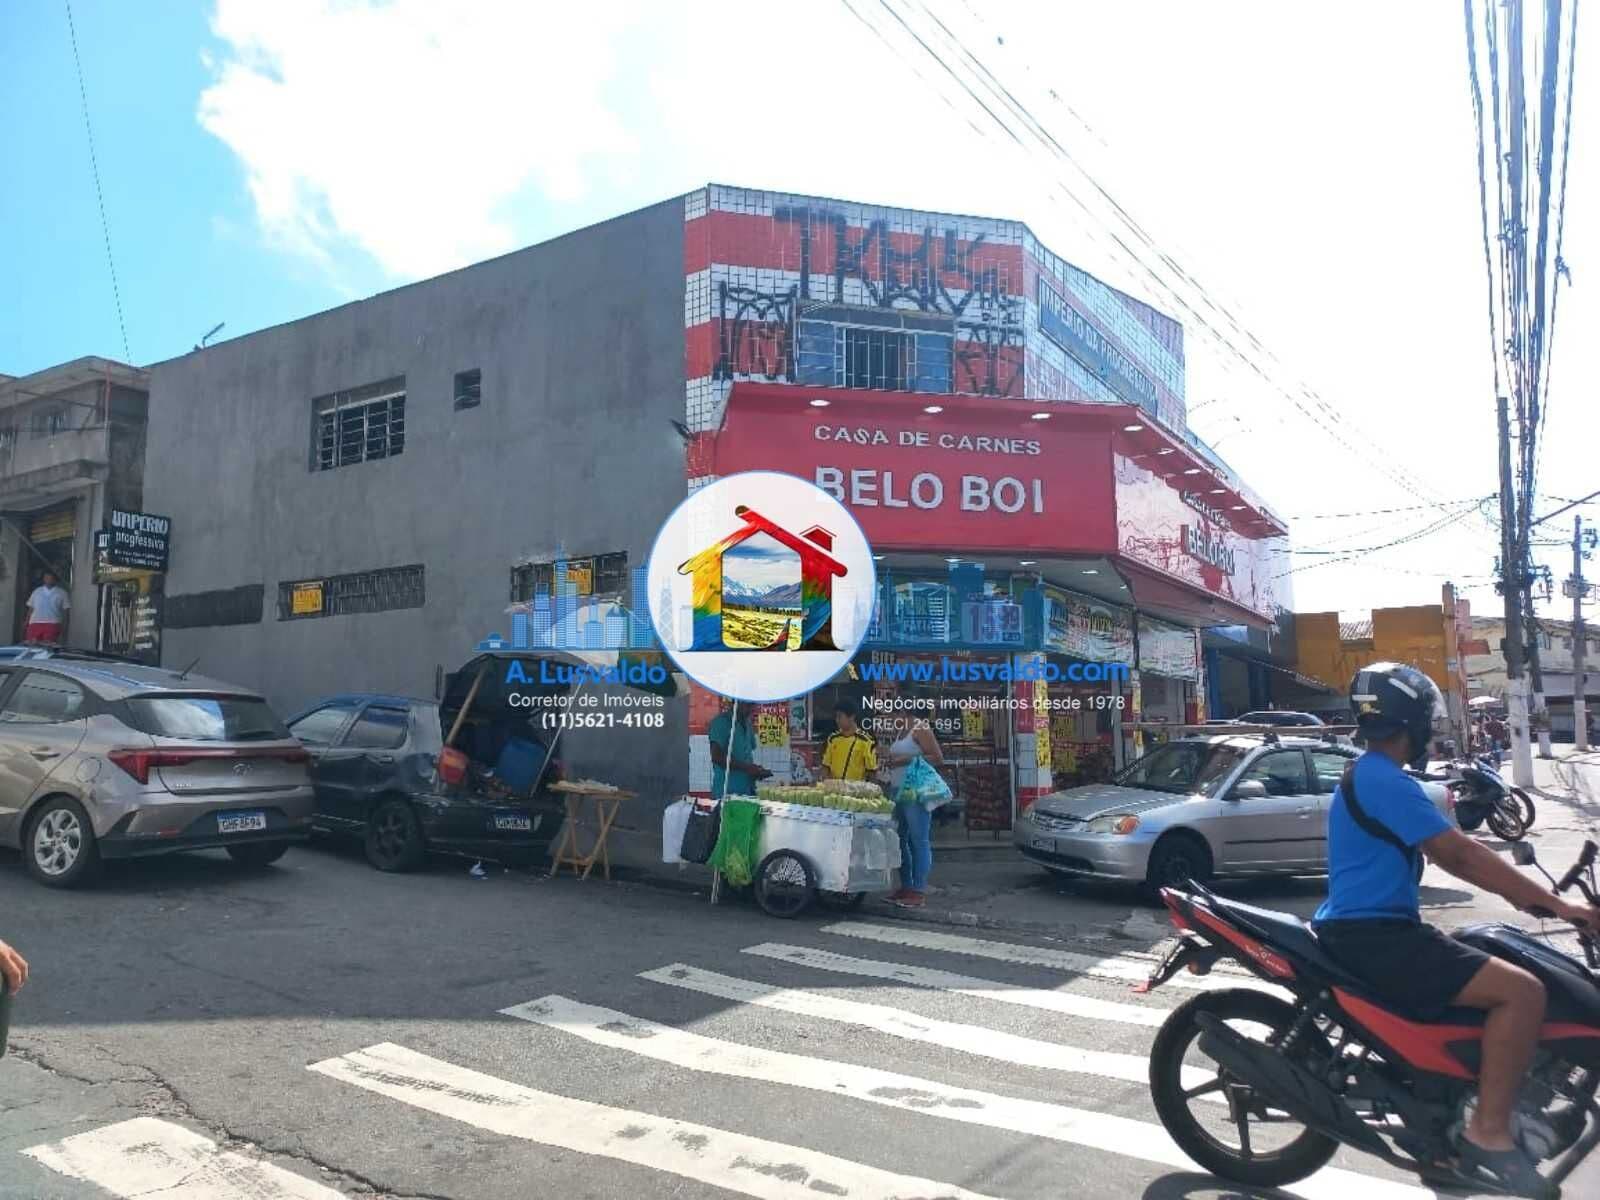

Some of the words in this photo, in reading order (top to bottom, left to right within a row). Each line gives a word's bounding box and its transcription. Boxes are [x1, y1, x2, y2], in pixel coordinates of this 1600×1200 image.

[815, 425, 889, 445] CASA
[899, 431, 930, 447] DE
[938, 434, 1041, 455] CARNES
[815, 466, 944, 510] BELO
[960, 475, 1044, 513] BOI
